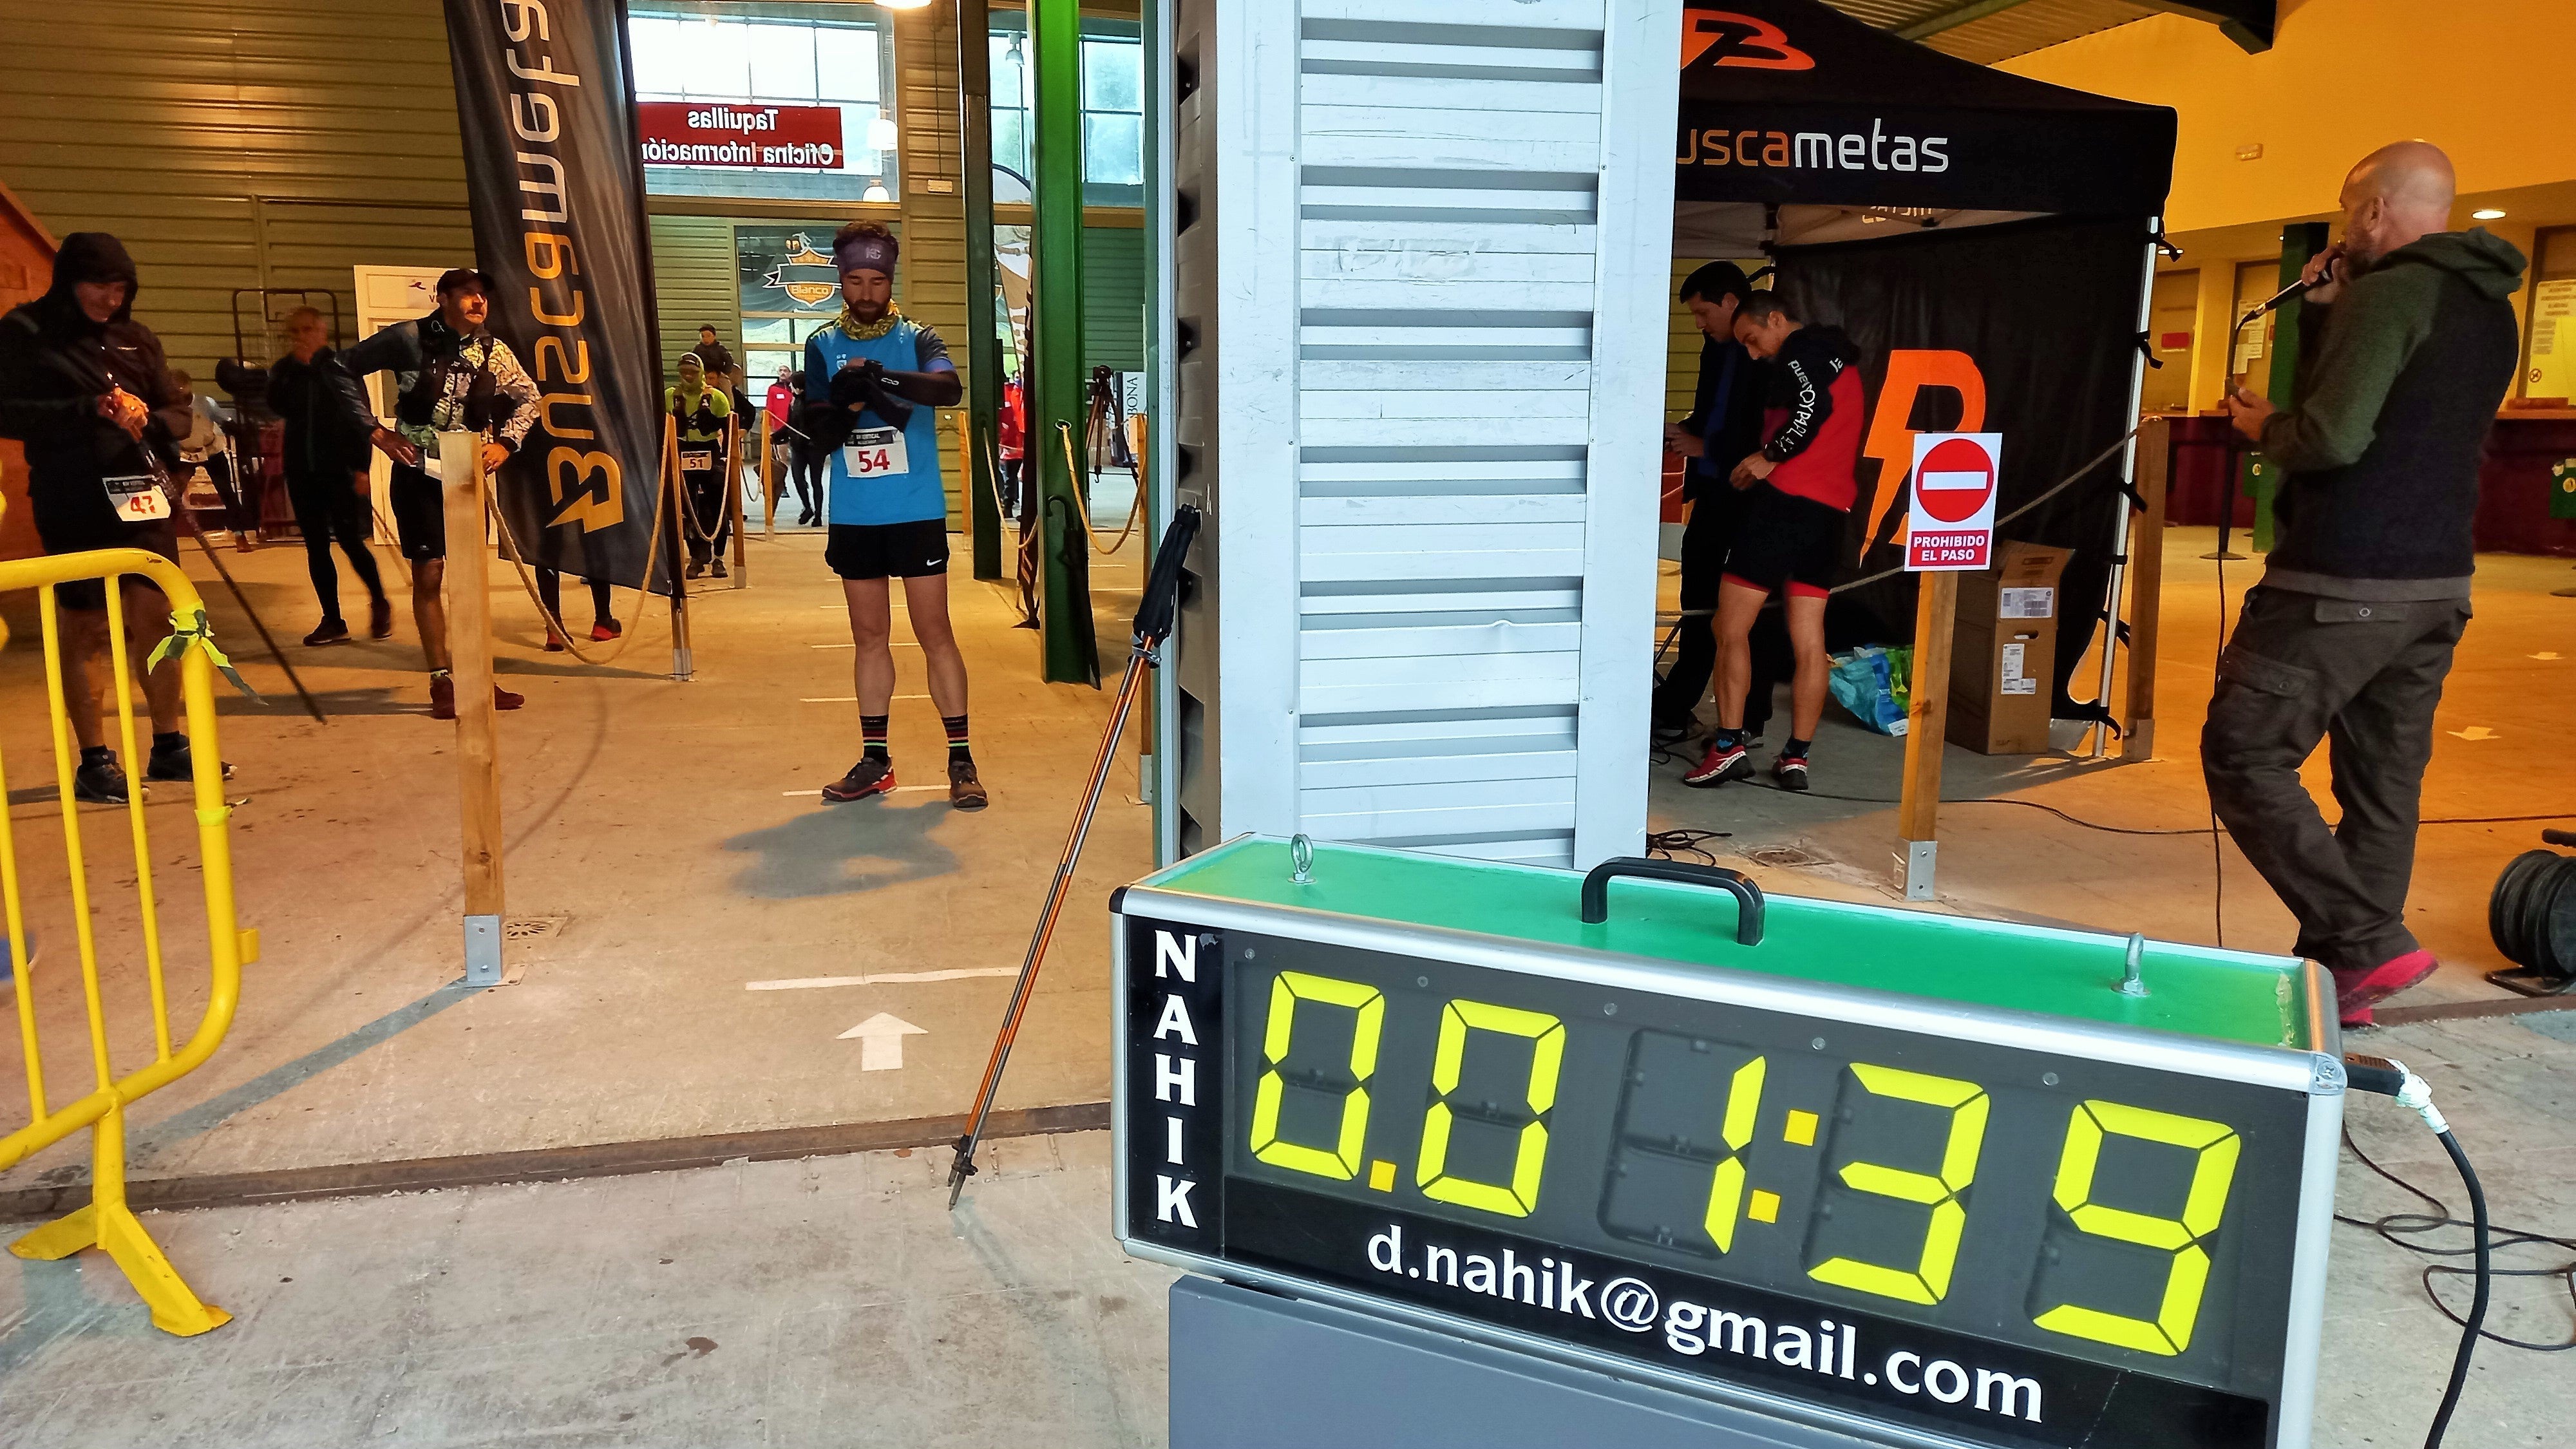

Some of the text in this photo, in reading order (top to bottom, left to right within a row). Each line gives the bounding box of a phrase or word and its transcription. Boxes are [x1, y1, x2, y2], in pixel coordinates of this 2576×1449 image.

[690, 458, 703, 468] 51
[858, 449, 890, 473] 54
[1913, 535, 1985, 548] PROHIBIDO
[1921, 549, 1975, 562] EL PASO
[1153, 930, 1198, 1229] NAHIK
[1367, 1226, 2043, 1424] d.nahik@gmail.com
